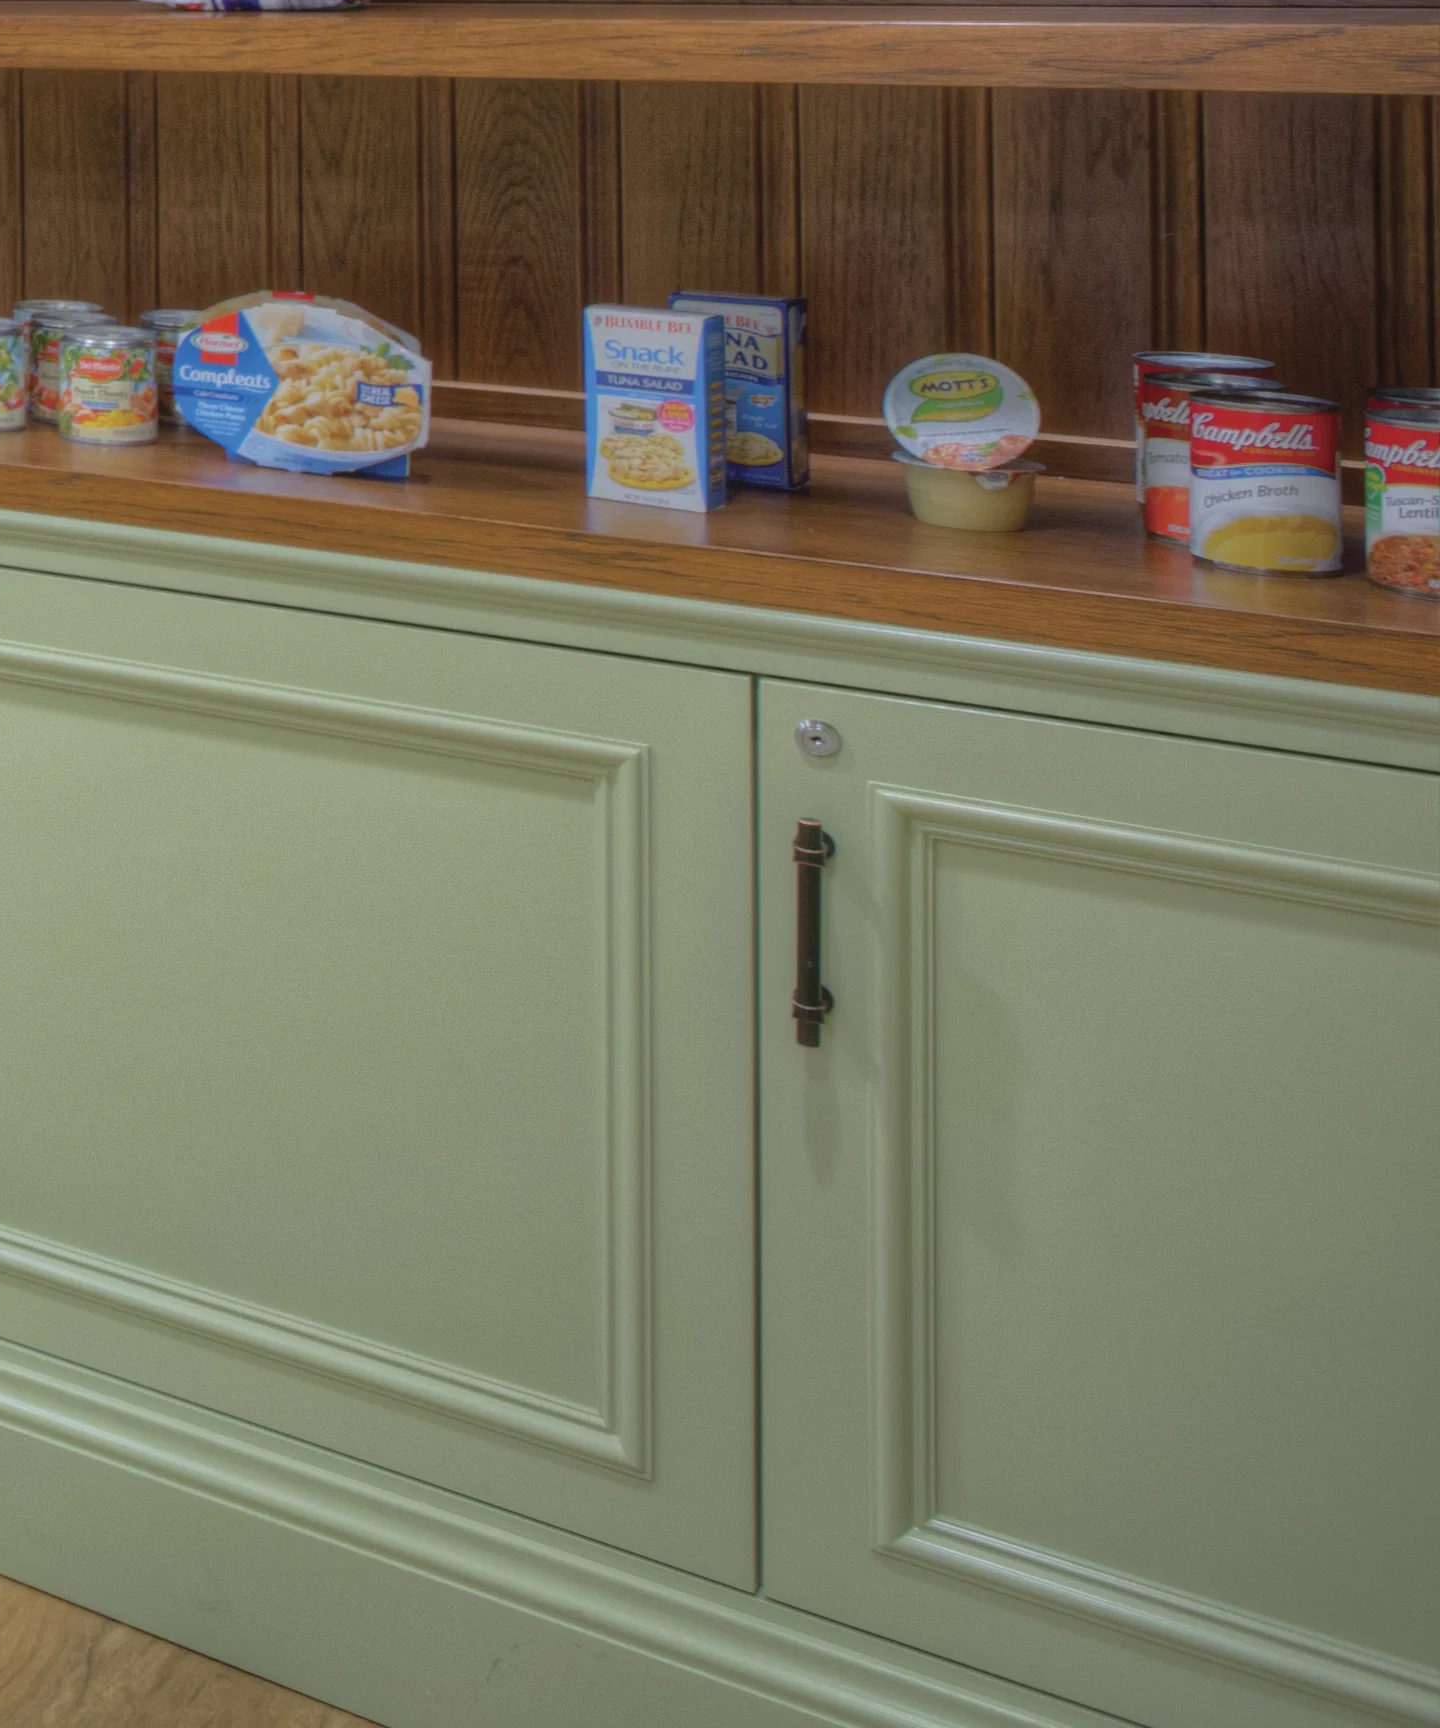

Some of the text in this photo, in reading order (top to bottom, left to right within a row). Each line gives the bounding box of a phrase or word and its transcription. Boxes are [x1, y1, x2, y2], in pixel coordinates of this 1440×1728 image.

[604, 315, 693, 335] BUMBLE BEE
[736, 315, 759, 330] BEE
[199, 336, 241, 349] Hormel
[726, 332, 761, 351] NA
[604, 339, 685, 366] Snack
[725, 351, 768, 371] LAD
[180, 364, 272, 390] Compleats
[607, 374, 684, 392] TUNA SALAD
[361, 394, 391, 405] CHEESE
[371, 387, 392, 397] REAL
[1191, 412, 1318, 451] Campbell's
[1244, 466, 1307, 476] COOKING
[1203, 484, 1300, 508] Chicken Broth
